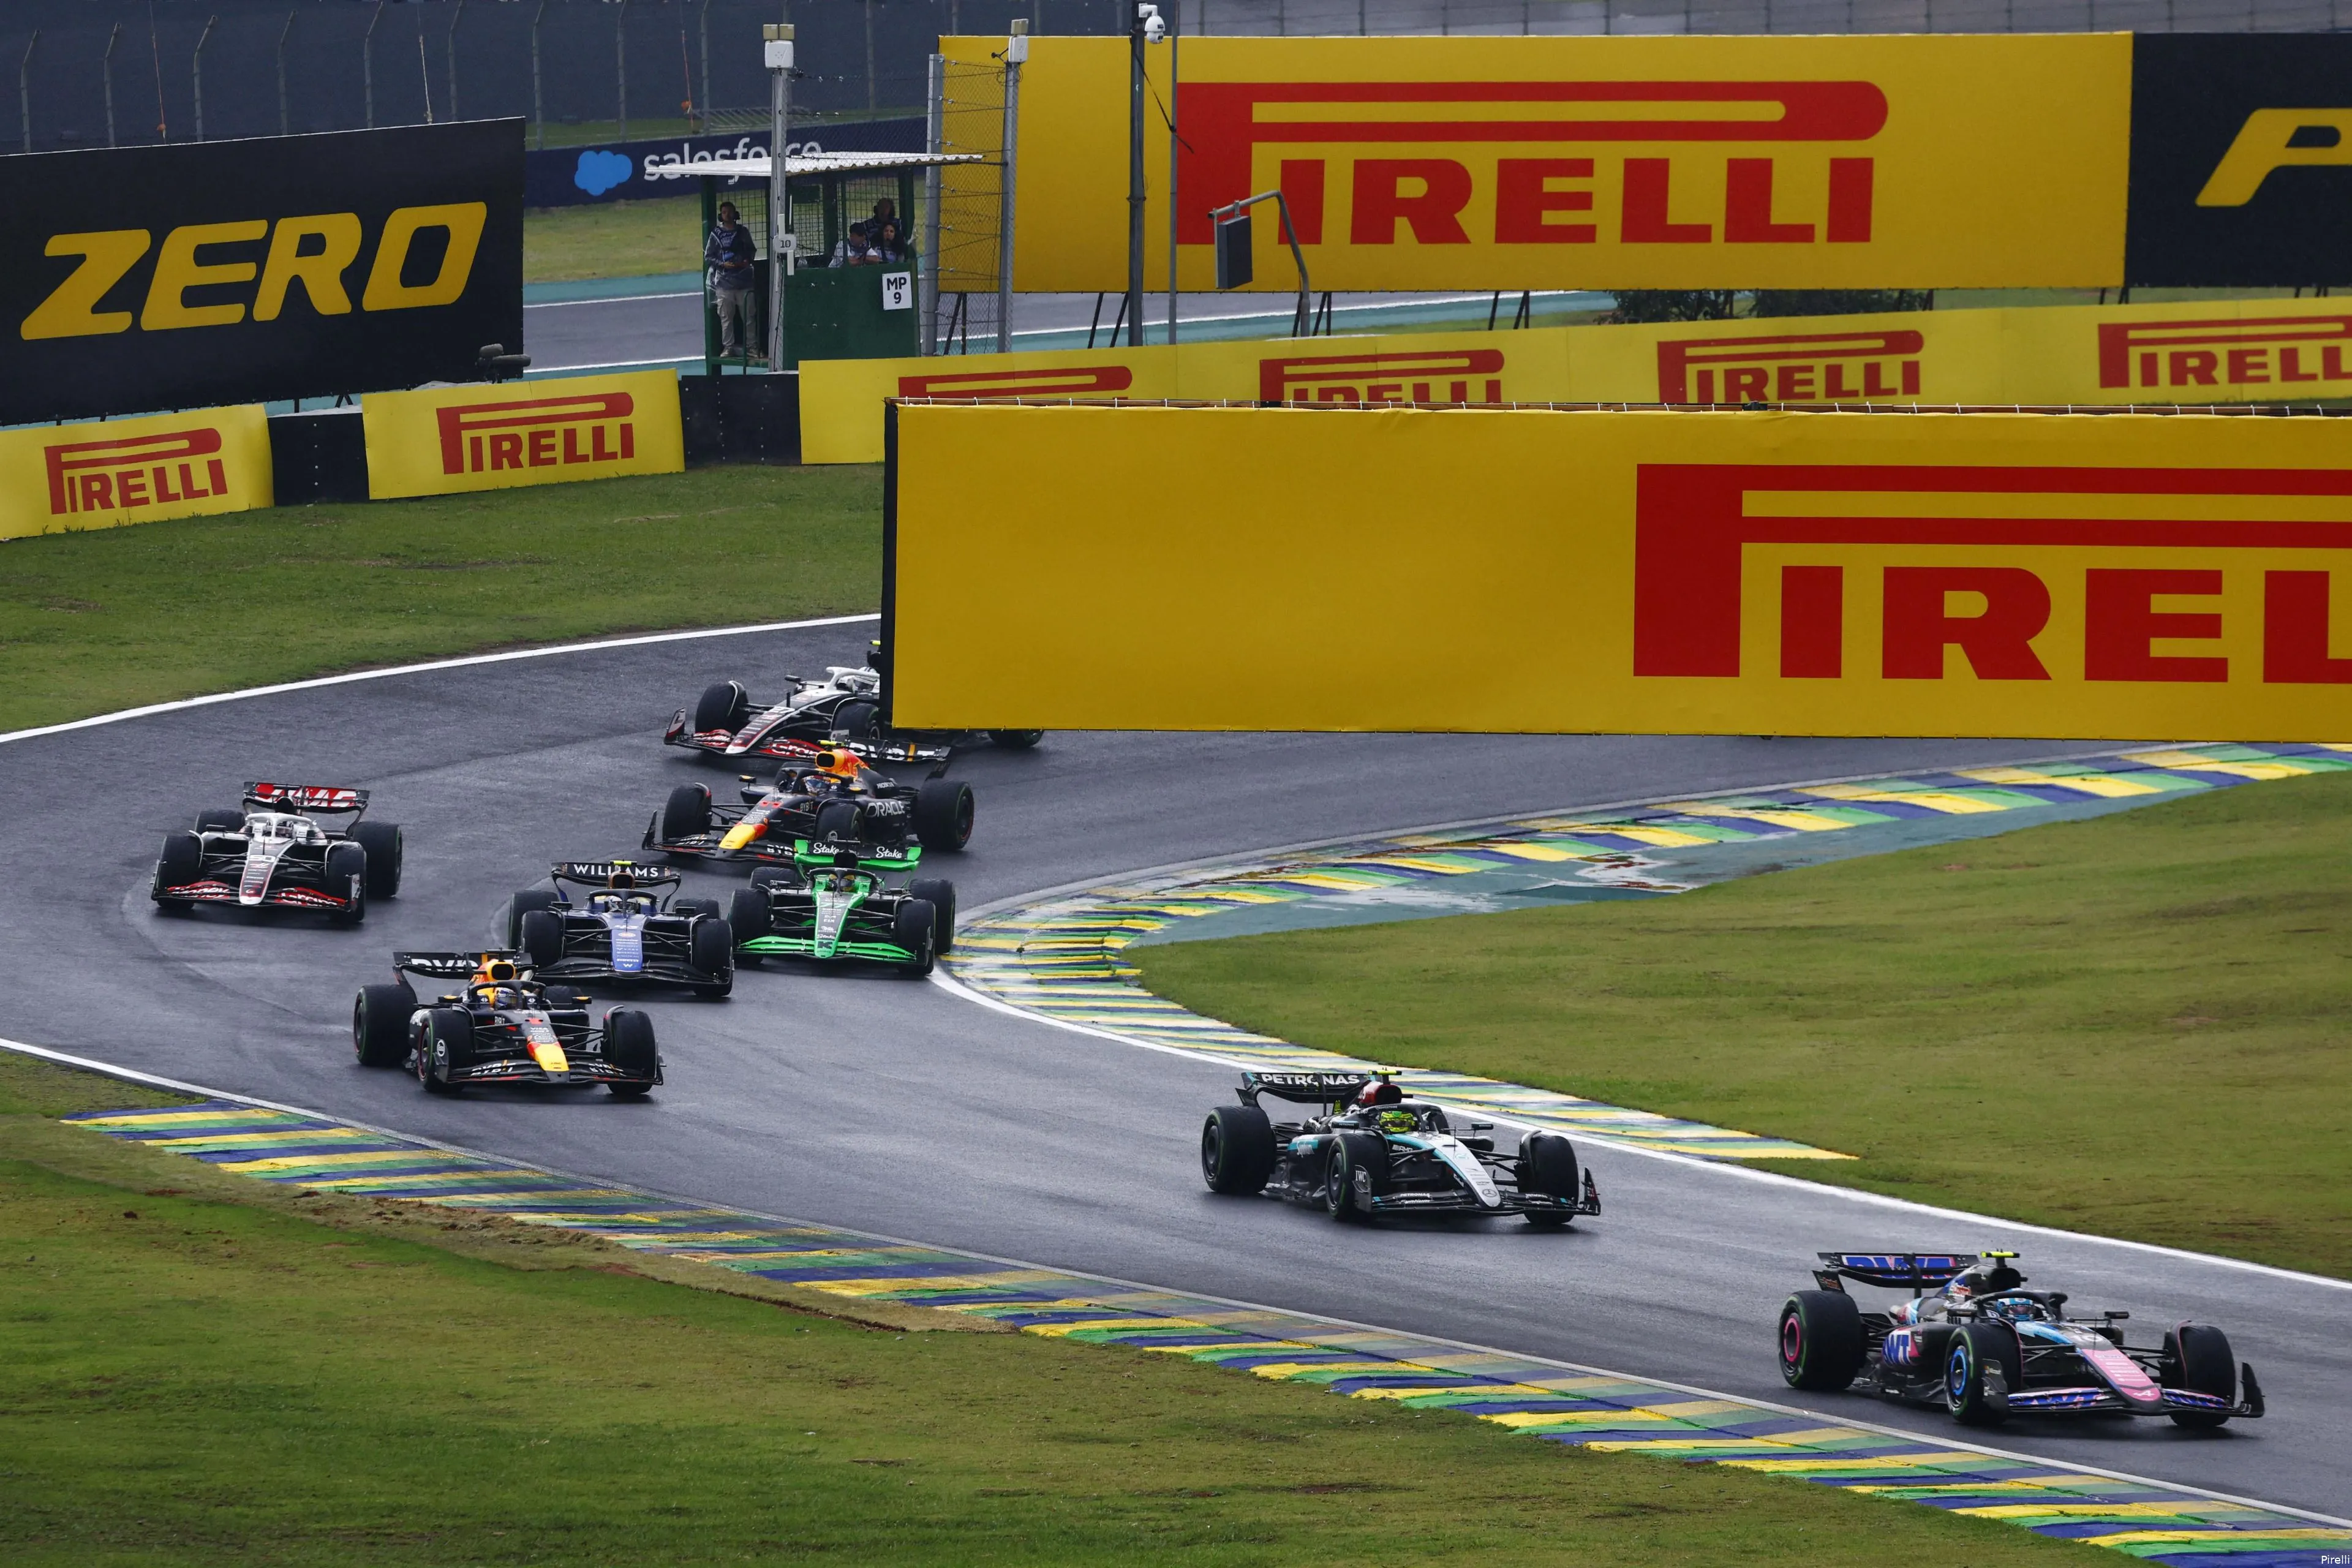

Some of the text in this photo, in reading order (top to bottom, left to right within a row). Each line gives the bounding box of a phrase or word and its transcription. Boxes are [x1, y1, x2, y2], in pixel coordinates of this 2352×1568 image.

[1176, 81, 1888, 244] PIRELLI
[2196, 108, 2352, 206] P
[780, 239, 791, 249] 10
[21, 202, 487, 340] ZERO
[887, 277, 907, 291] MP
[894, 292, 902, 304] 9
[1657, 330, 1924, 403] PIRELLI
[437, 393, 635, 475] PIRELLI
[45, 428, 228, 514] PIRELLI
[864, 799, 906, 818] ORACLE
[813, 842, 840, 854] Stake
[876, 846, 902, 859] Stake
[1262, 1074, 1360, 1087] PETRONAS
[1355, 1170, 1367, 1183] IWC
